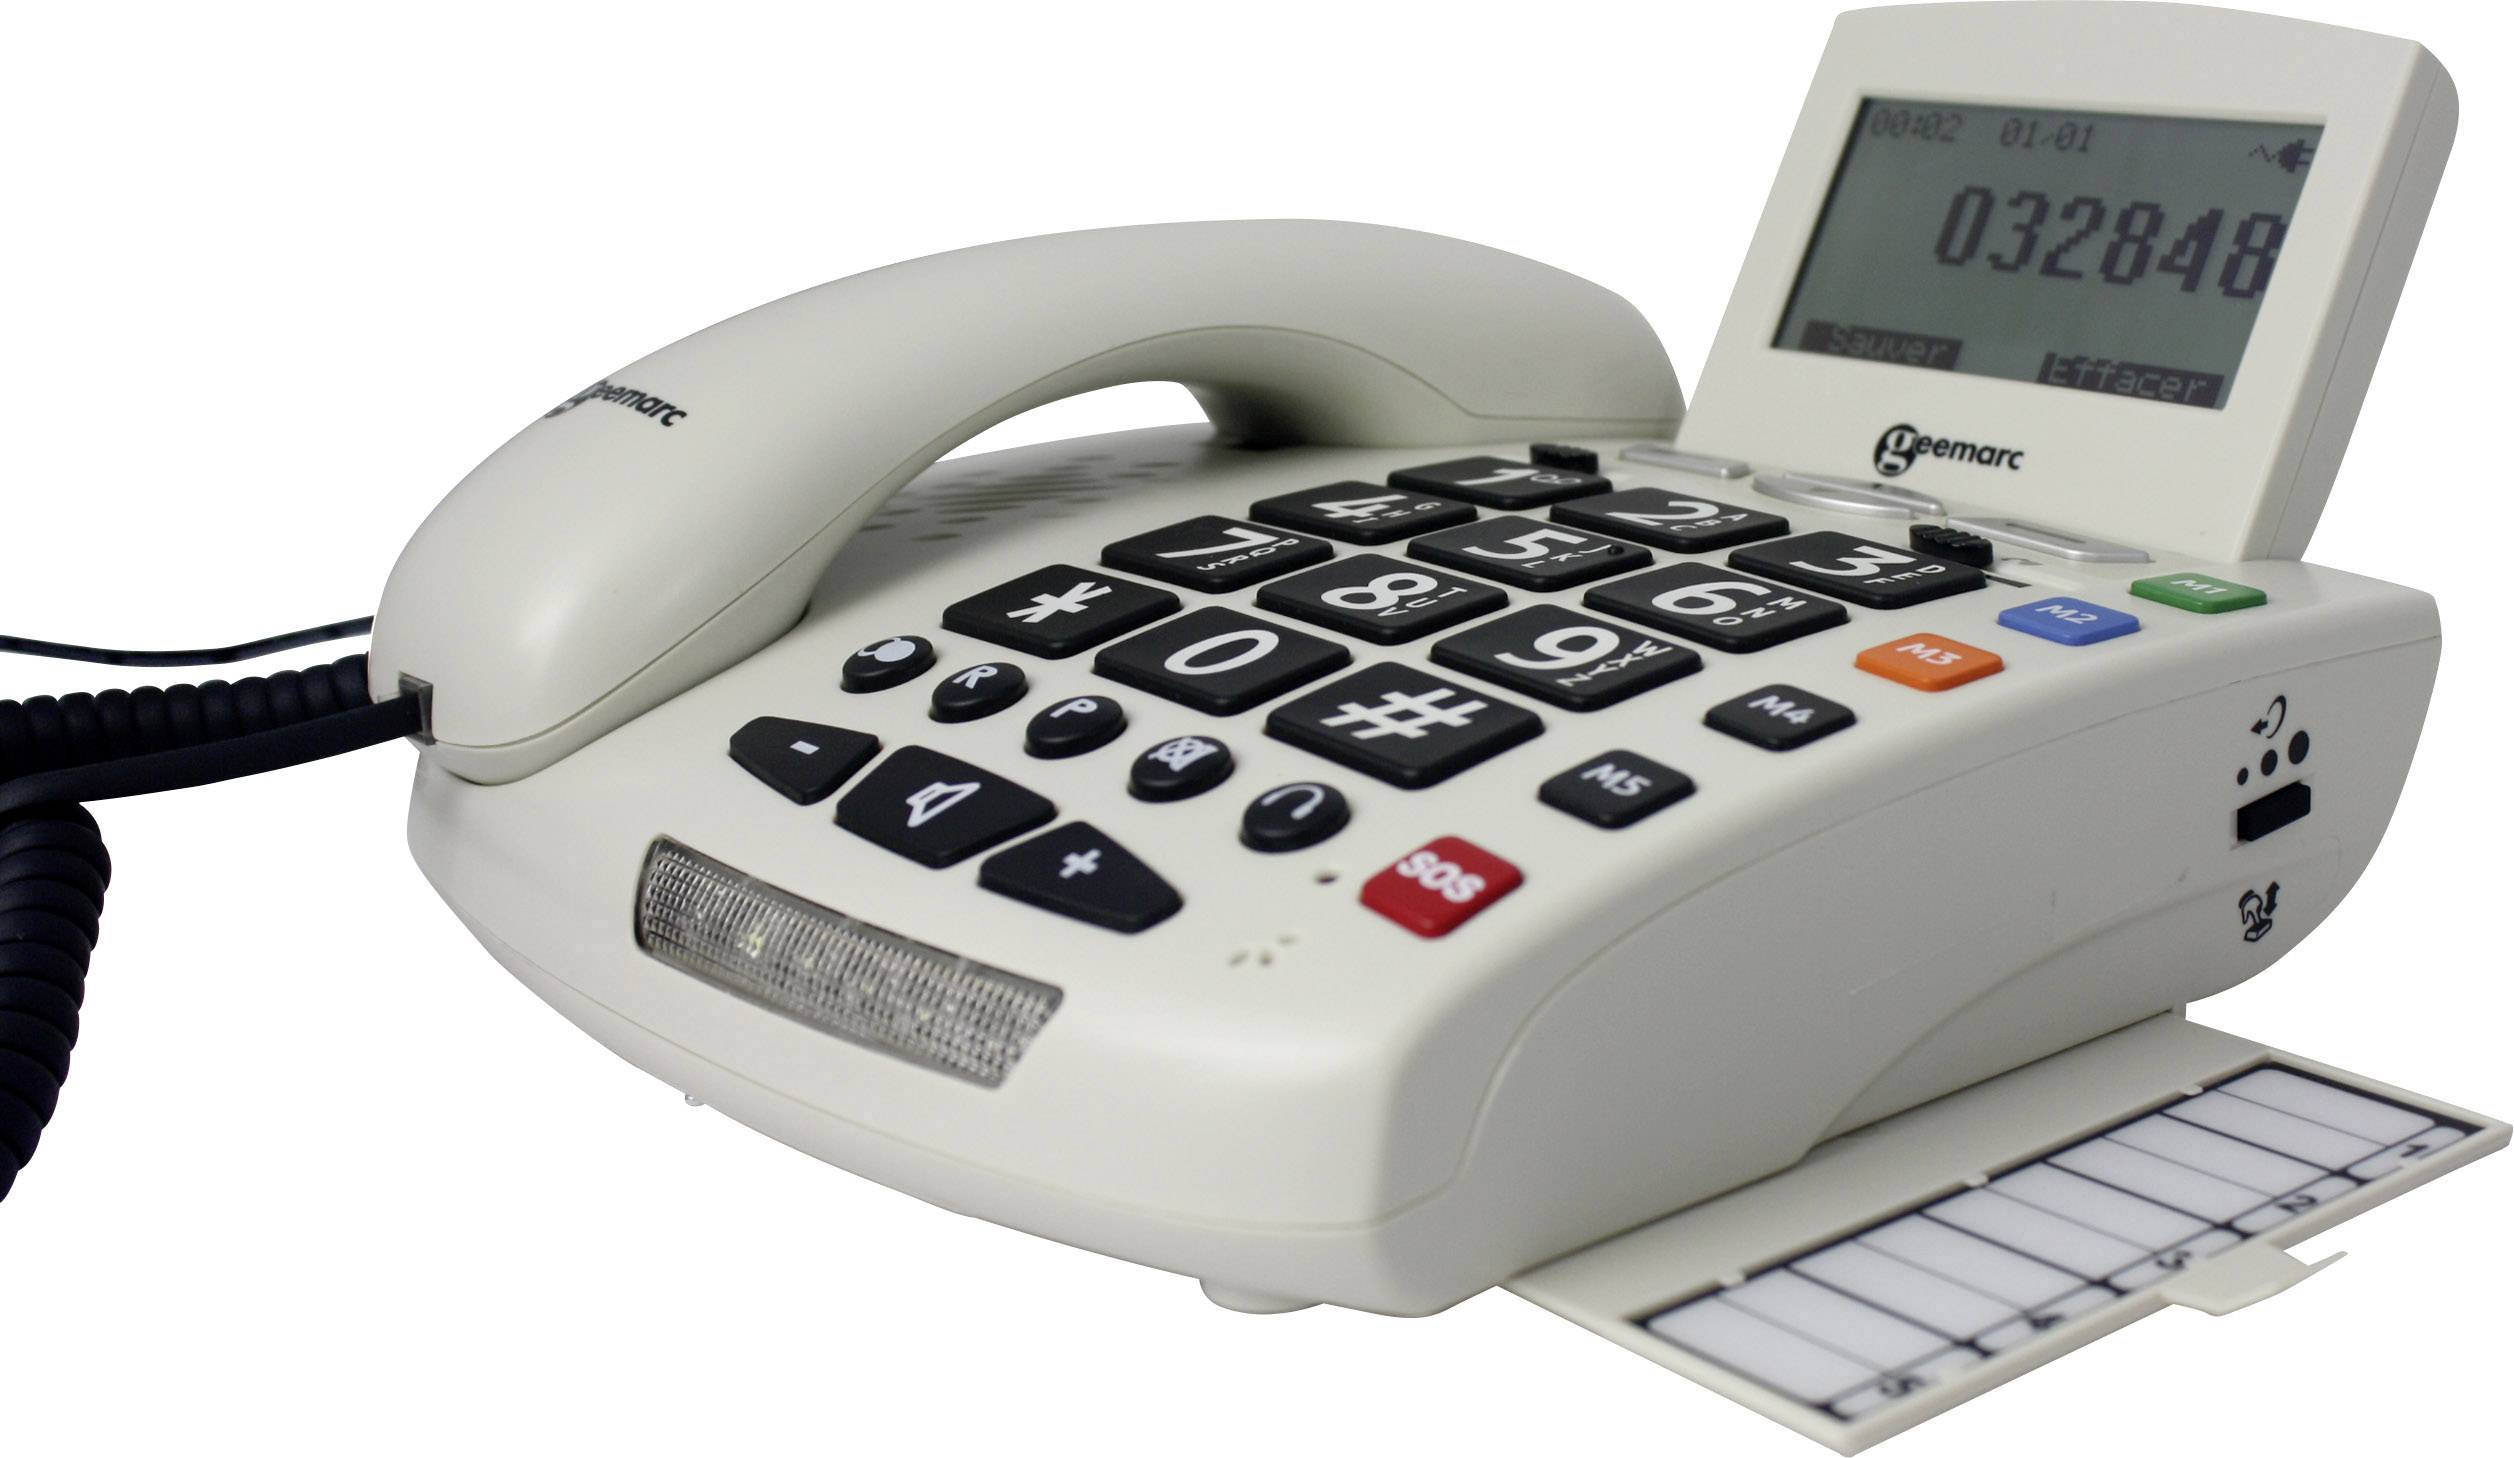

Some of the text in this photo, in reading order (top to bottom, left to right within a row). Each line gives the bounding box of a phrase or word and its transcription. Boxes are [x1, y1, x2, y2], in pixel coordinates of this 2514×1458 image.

[1935, 185, 2288, 299] 032848
[1828, 326, 1951, 366] Sauver
[2047, 354, 2208, 402] Effacer
[1873, 422, 2025, 478] geemarc
[1455, 467, 1541, 487] 1
[1311, 493, 1409, 519] 4
[1606, 500, 1720, 527] 2
[1156, 526, 1281, 559] 7
[1462, 528, 1589, 560] 5
[1789, 545, 1918, 577] 3
[1320, 571, 1439, 611] 8
[1651, 580, 1773, 616] 6
[2169, 578, 2228, 595] M1
[2034, 603, 2099, 625] M2
[1163, 629, 1281, 676] 0
[1493, 625, 1620, 671] 9
[1896, 641, 1964, 666] M3
[952, 664, 998, 690] R
[1049, 697, 1099, 719] P
[1747, 694, 1815, 725] M4
[1580, 762, 1652, 797] M5
[1396, 850, 1487, 904] SOS
